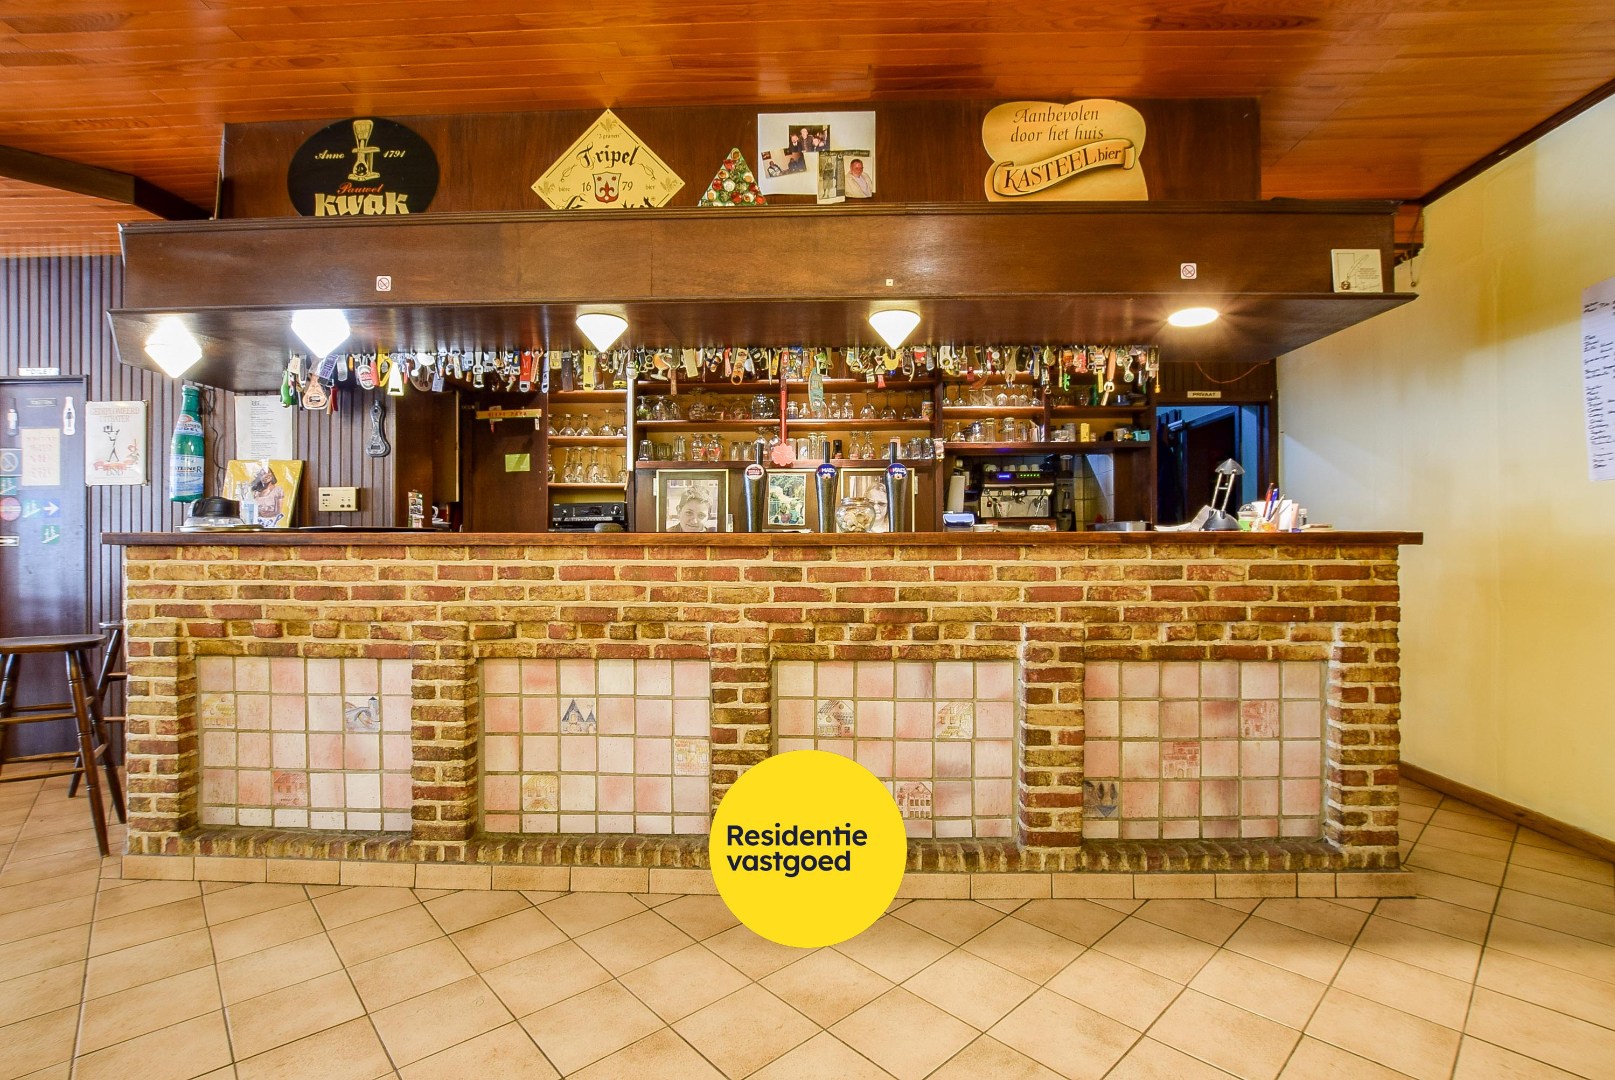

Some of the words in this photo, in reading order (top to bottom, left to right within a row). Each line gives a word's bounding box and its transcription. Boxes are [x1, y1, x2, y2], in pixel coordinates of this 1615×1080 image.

[1013, 104, 1100, 124] Aanbevolen
[1010, 126, 1043, 143] door
[1048, 124, 1069, 141] het
[1074, 123, 1104, 140] huis
[314, 149, 345, 160] Anno
[383, 149, 406, 158] 1791
[576, 141, 641, 170] Tripel
[1003, 147, 1097, 193] KASTEEL
[1097, 146, 1122, 162] bier
[336, 182, 384, 195] Pauwel
[582, 182, 592, 192] 16
[622, 181, 633, 191] 79
